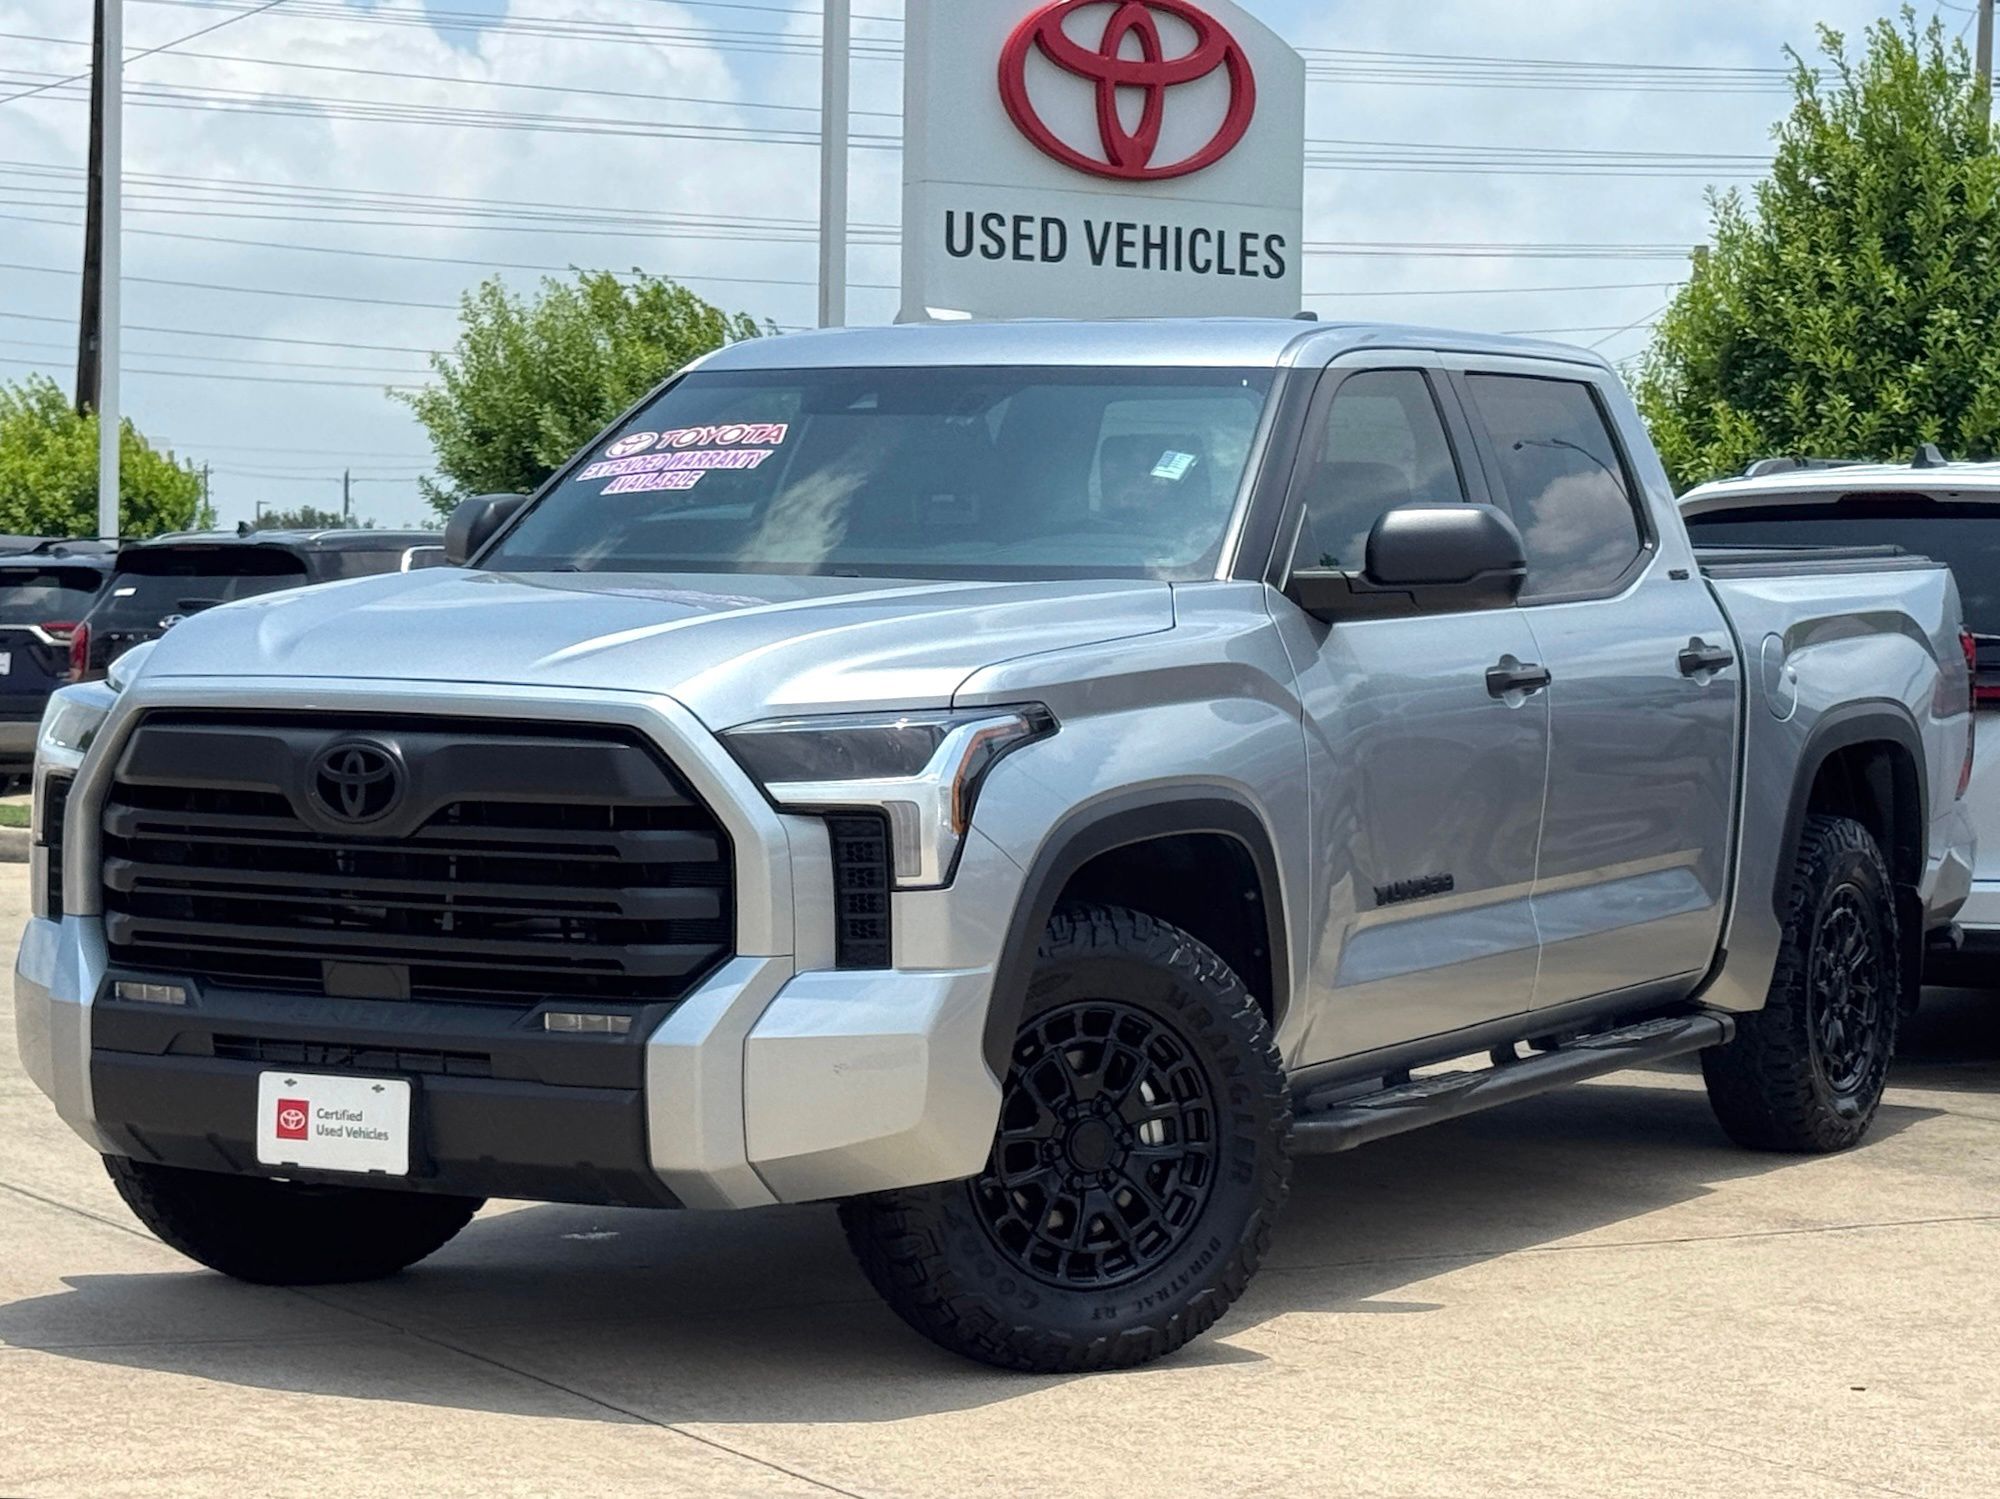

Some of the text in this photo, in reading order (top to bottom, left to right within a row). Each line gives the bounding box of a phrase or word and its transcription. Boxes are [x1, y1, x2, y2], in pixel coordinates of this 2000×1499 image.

[945, 210, 1286, 279] USED VEHICLES
[656, 425, 787, 449] TOYOTA
[580, 450, 770, 479] EXTENDED WARRANTY
[605, 471, 703, 493] AVAILABLE
[1168, 982, 1256, 1185] WRANGLER
[316, 1108, 363, 1122] Certified
[316, 1124, 389, 1141] Used Vehicles
[1137, 1237, 1222, 1312] DURATRAC
